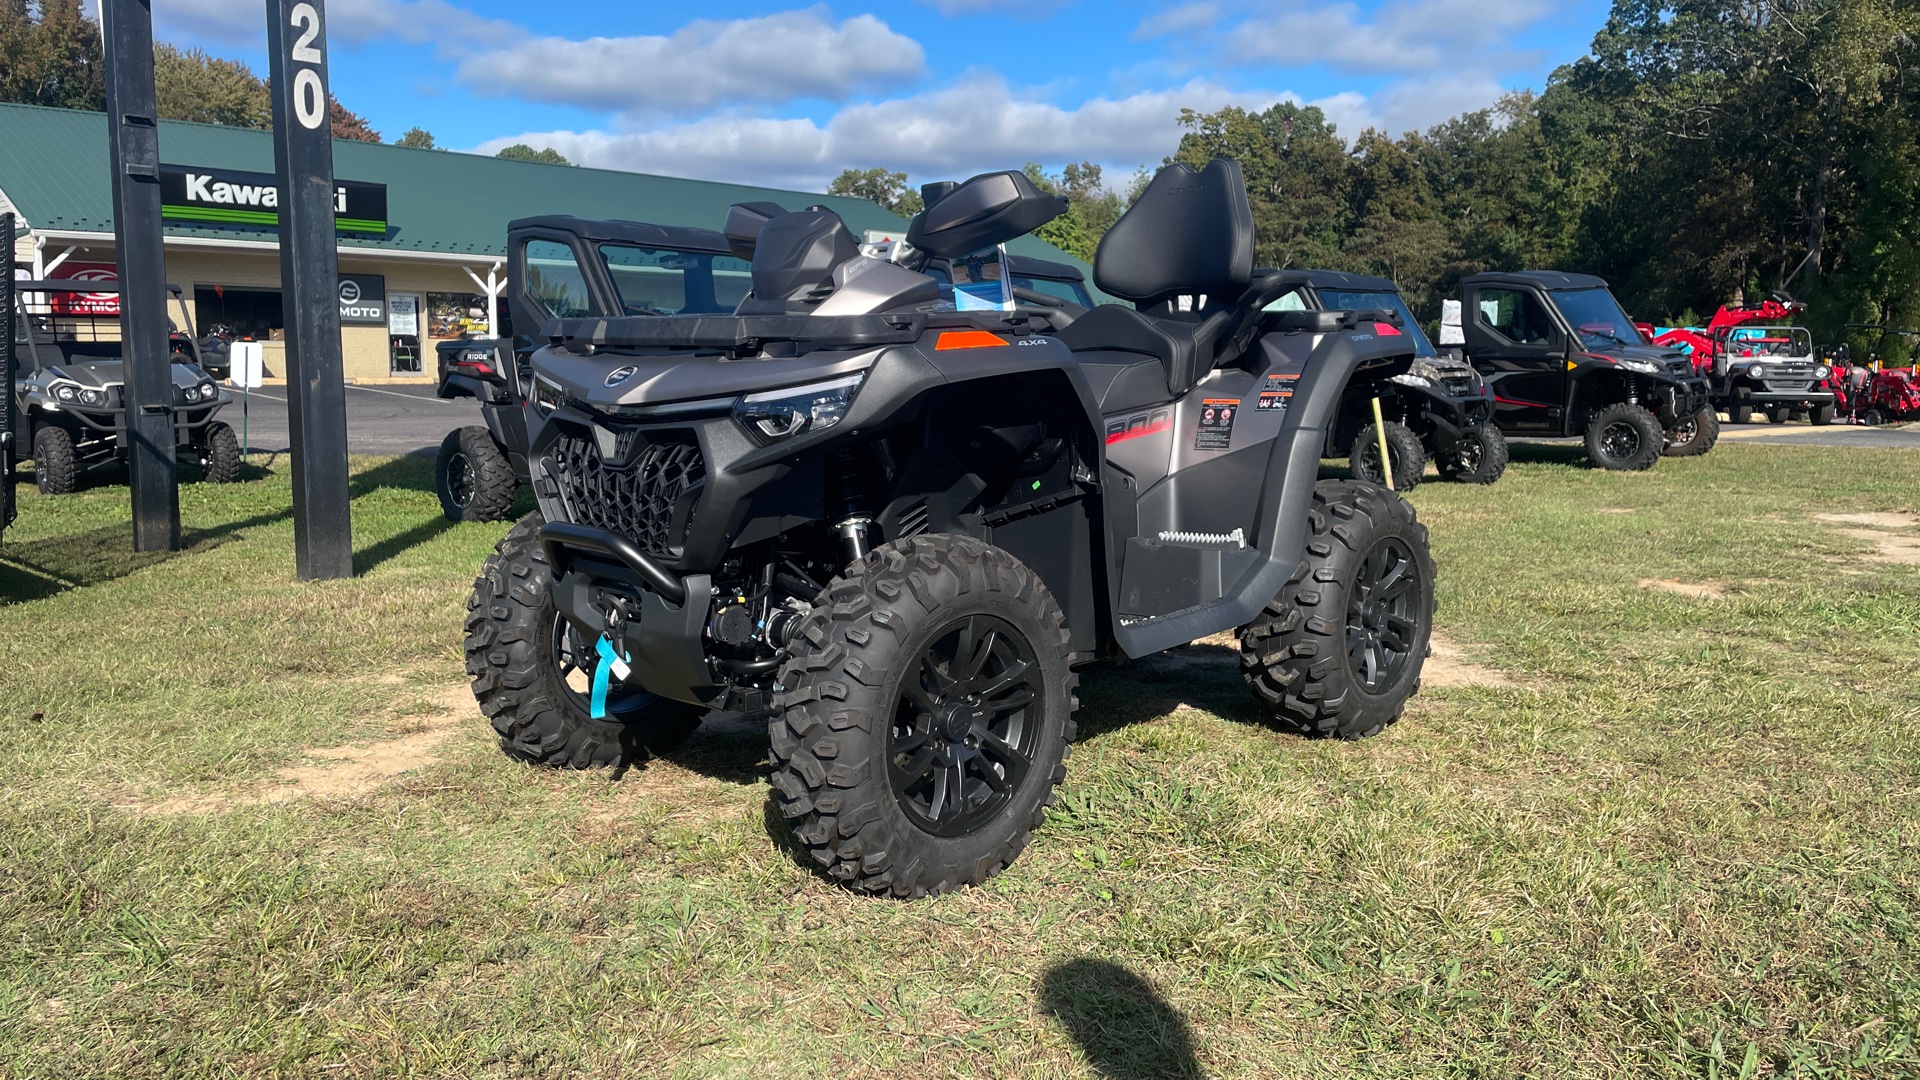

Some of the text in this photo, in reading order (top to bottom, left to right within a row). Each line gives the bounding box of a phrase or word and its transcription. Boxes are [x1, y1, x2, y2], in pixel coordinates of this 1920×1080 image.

[186, 173, 347, 212] Kawai
[849, 258, 868, 274] EPS
[340, 307, 381, 317] MOTO
